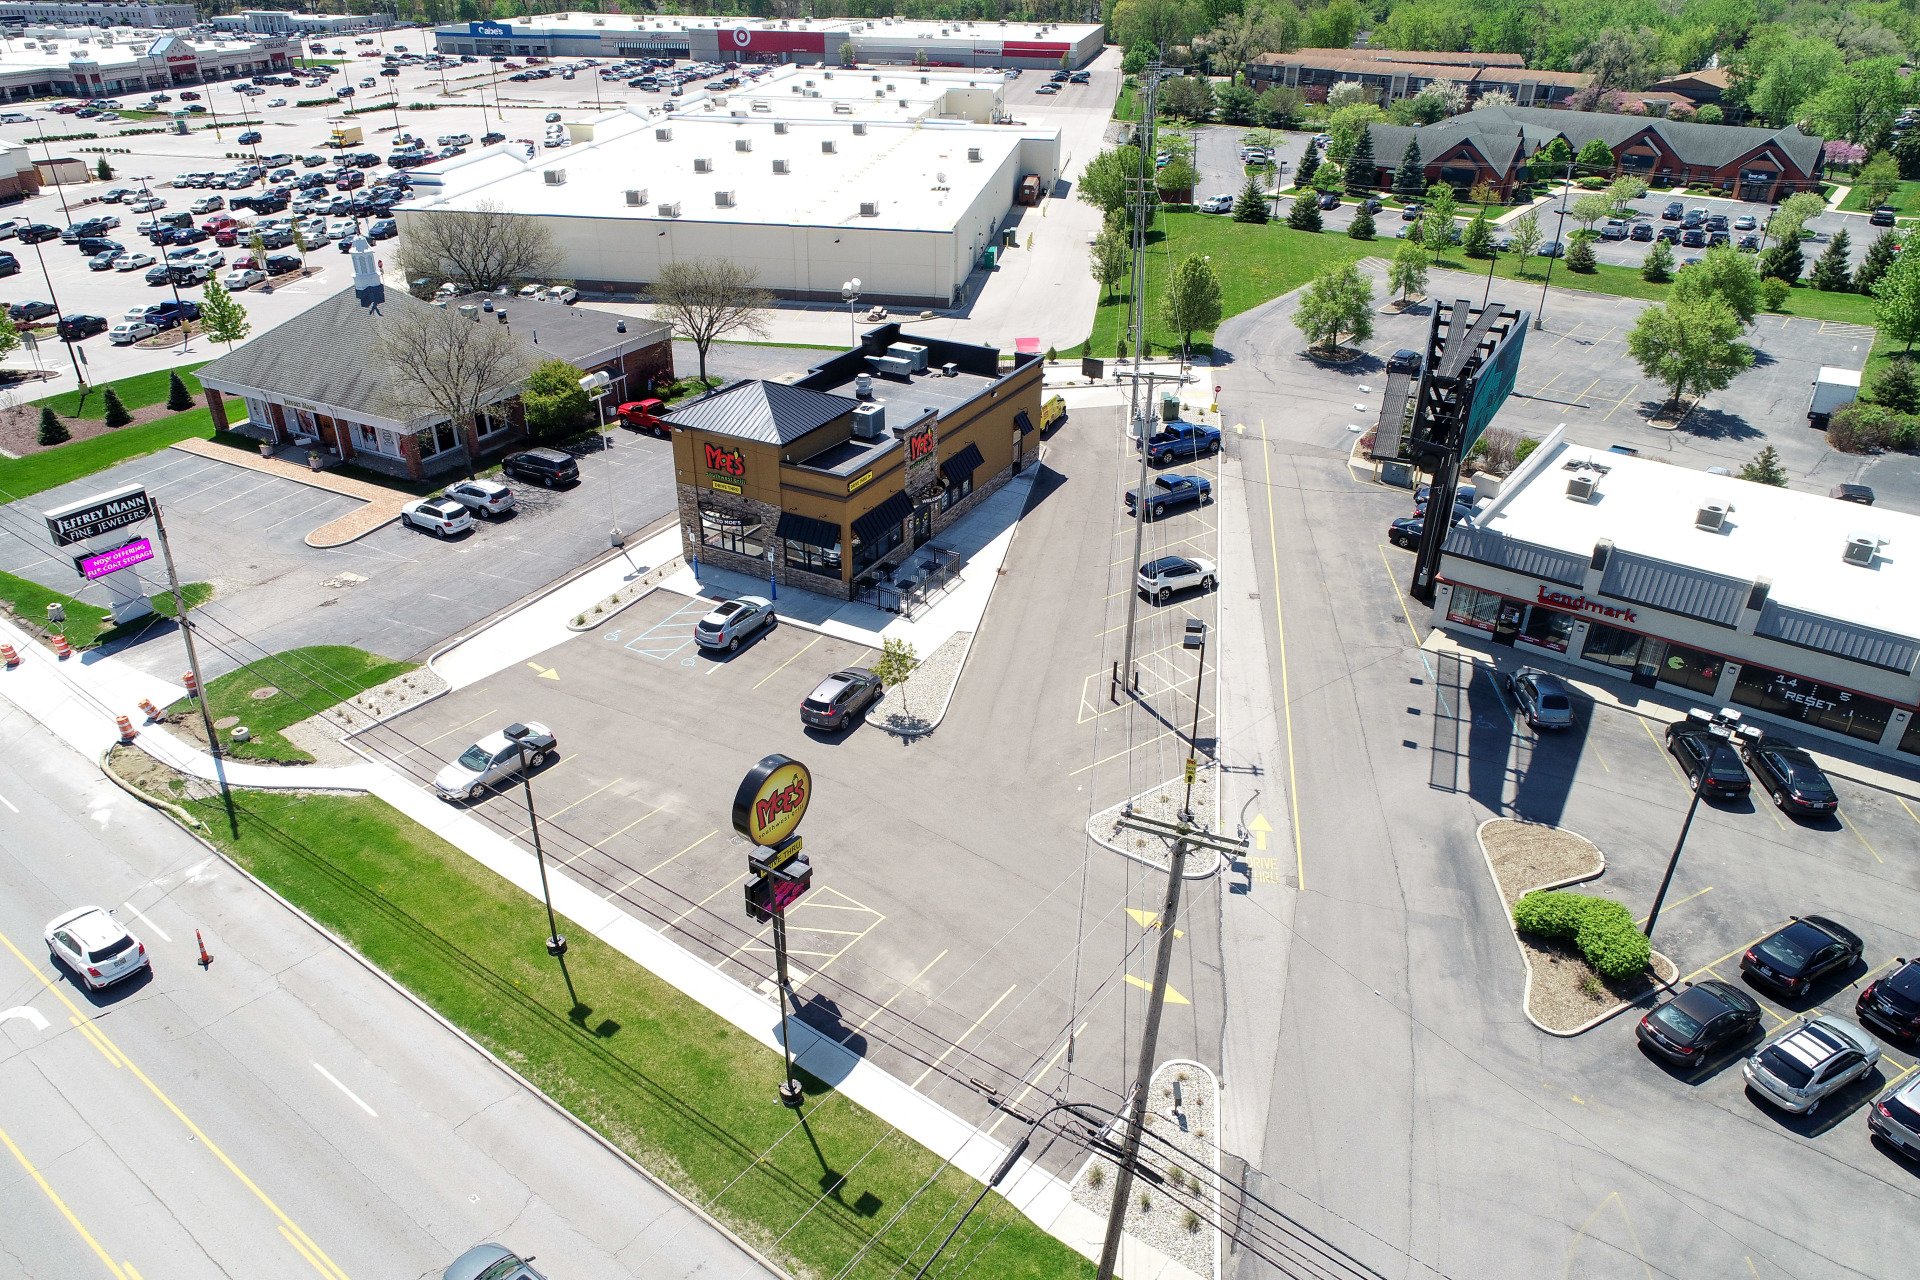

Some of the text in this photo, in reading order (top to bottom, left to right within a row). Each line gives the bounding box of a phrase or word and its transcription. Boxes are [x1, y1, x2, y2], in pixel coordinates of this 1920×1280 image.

[57, 496, 146, 535] JEFFREY MANN
[70, 508, 147, 541] FINE JEWELERS
[87, 567, 103, 578] FUR
[102, 561, 122, 572] COAT
[93, 544, 147, 567] NOW OFFERING
[1537, 585, 1638, 623] Lendmark
[1775, 674, 1852, 702] 14 5
[1784, 691, 1837, 711] RESET
[758, 803, 805, 840] southwest grill
[782, 840, 802, 860] THRU
